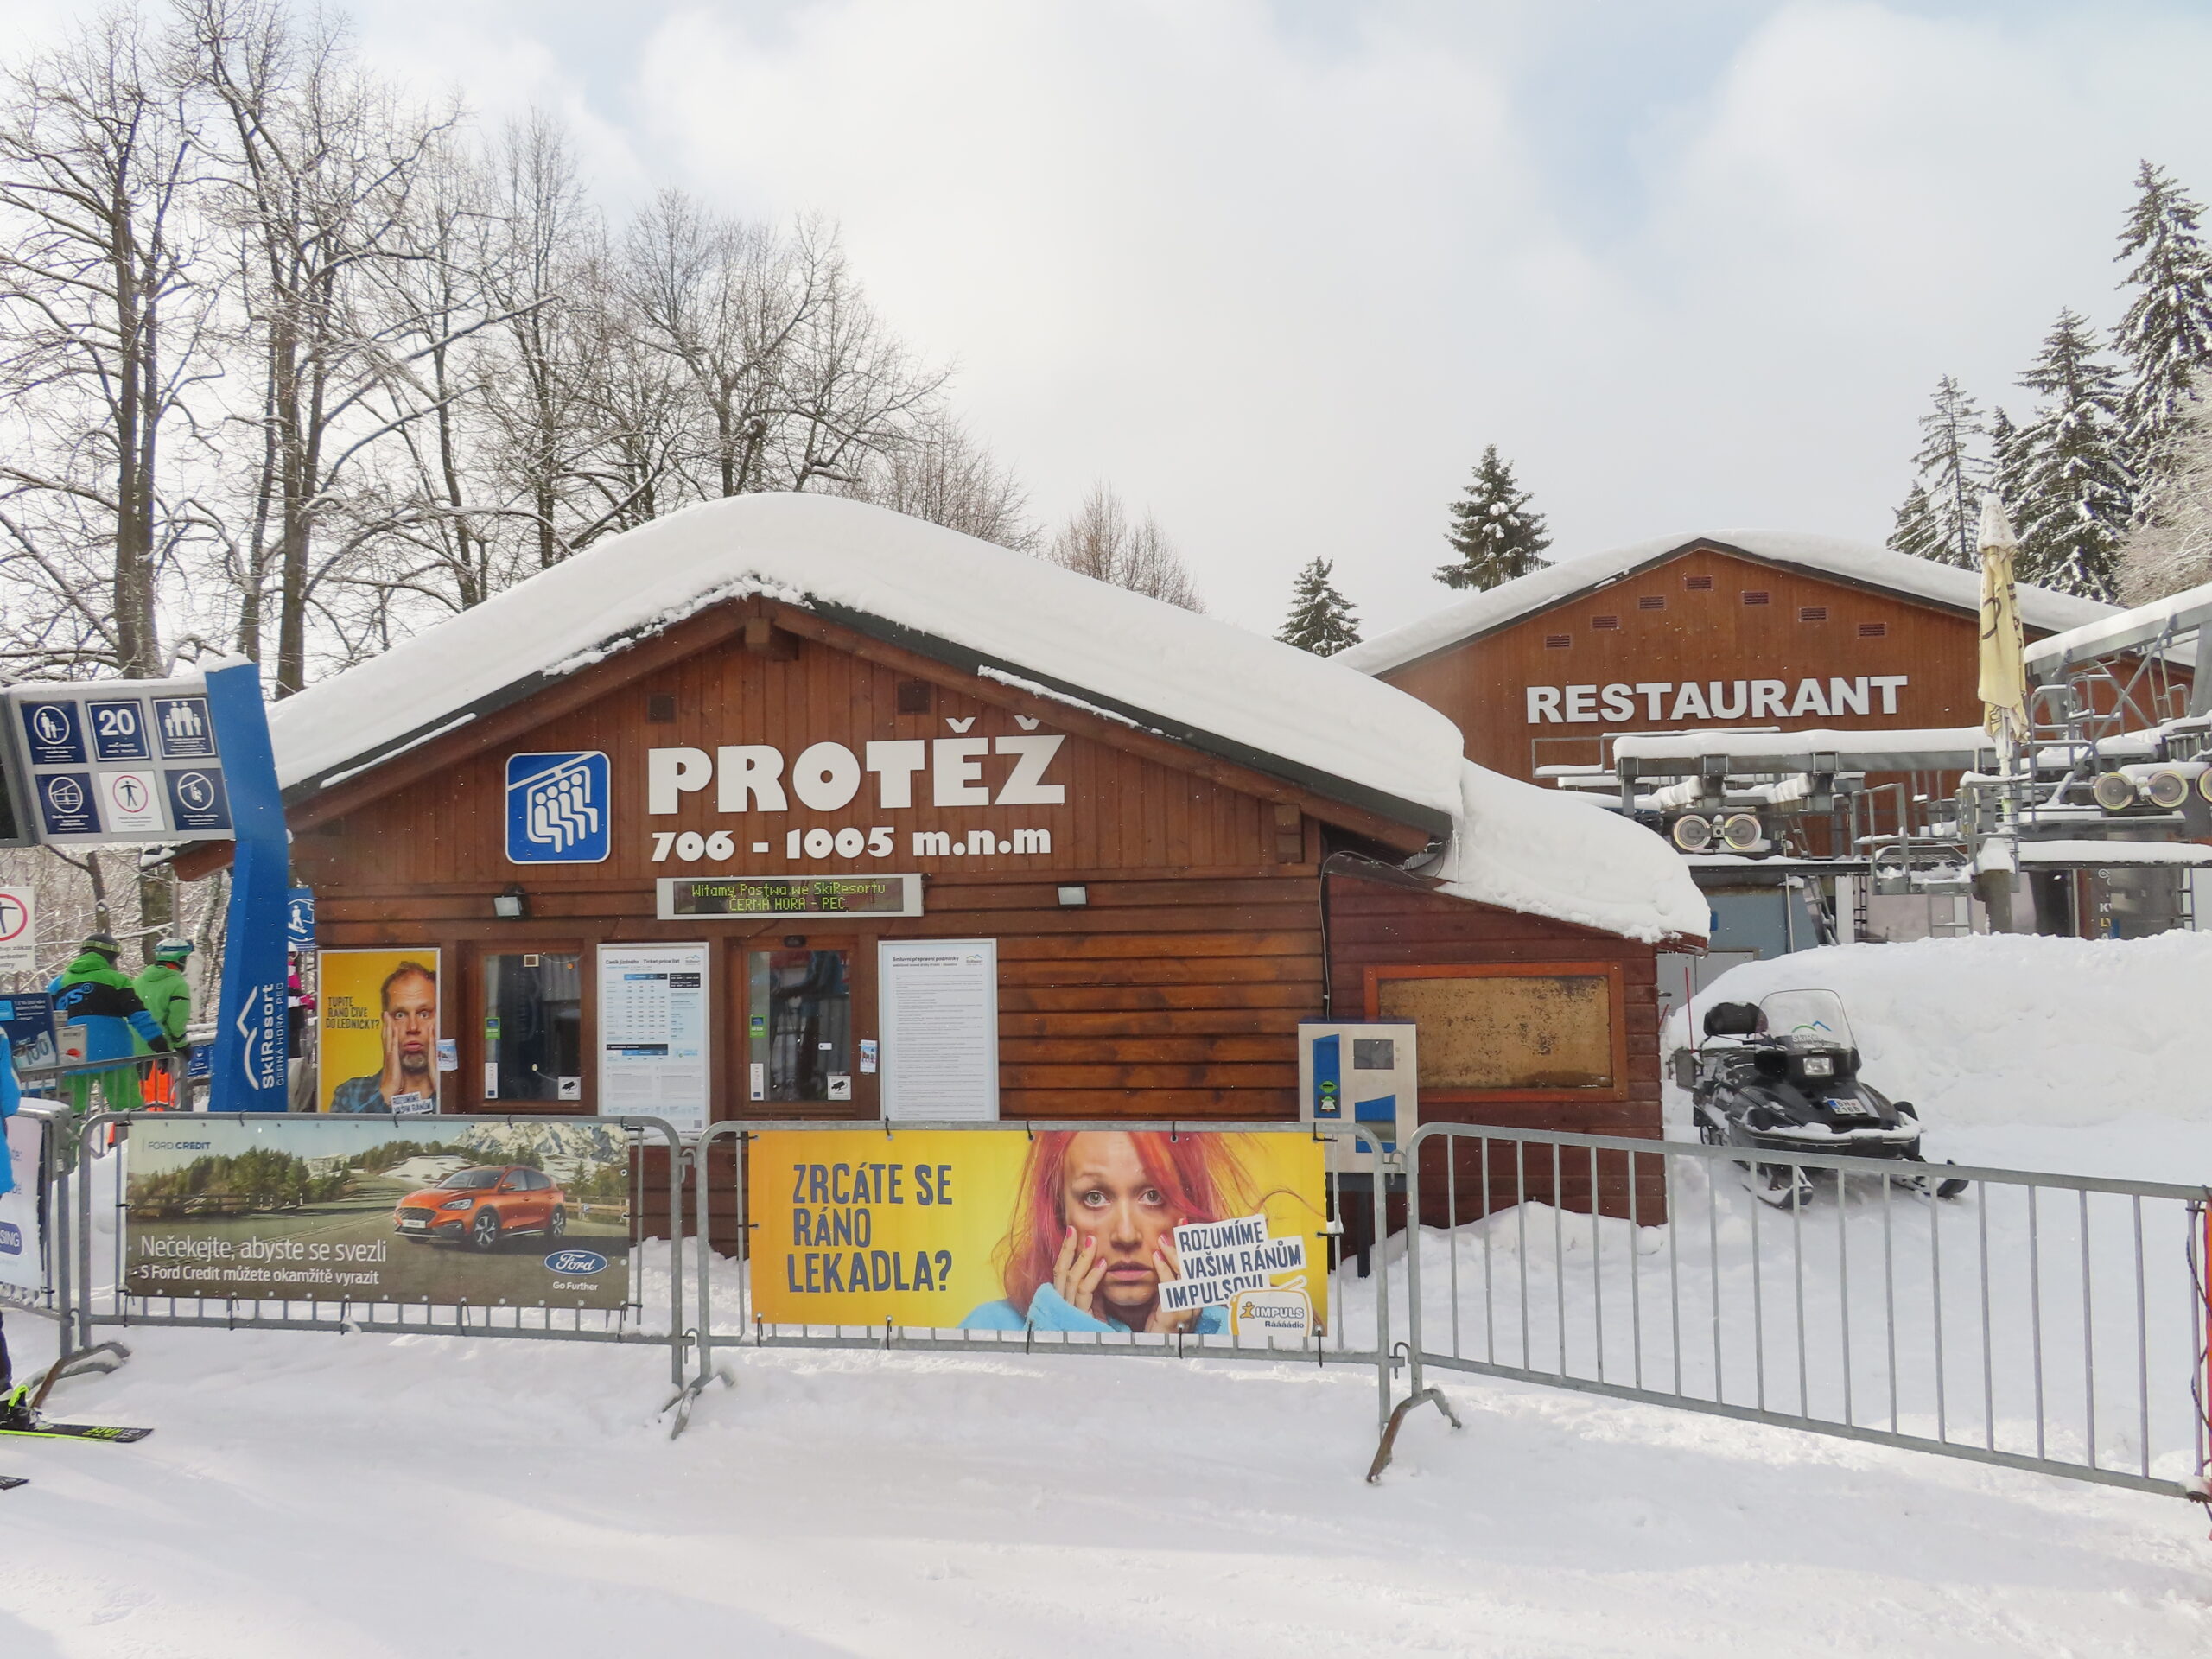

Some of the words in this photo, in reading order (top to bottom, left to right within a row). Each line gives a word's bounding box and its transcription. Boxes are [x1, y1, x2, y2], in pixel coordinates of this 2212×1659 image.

[1526, 675, 1909, 724] RESTAURANT
[99, 709, 136, 736] 20
[649, 715, 1066, 815] PROTĚŽ
[650, 830, 734, 862] 706
[785, 826, 895, 860] 1005
[912, 828, 1052, 857] m.n.m
[691, 885, 734, 897] Witamy
[791, 886, 809, 895] we
[814, 882, 886, 895] SkiResortu
[774, 898, 806, 911] HORA
[822, 897, 847, 910] PEC
[261, 983, 275, 1090] SkiResort
[276, 1013, 284, 1045] HORA
[148, 1141, 174, 1150] FORD
[175, 1141, 211, 1150] CREDIT
[793, 1162, 904, 1204] ZRCÁTE
[914, 1164, 953, 1205] SE
[793, 1206, 871, 1248] RÁNO
[1179, 1219, 1264, 1253] ROZUMÍME
[141, 1235, 235, 1262] Nečekejte,
[240, 1236, 304, 1263] abyste
[309, 1243, 330, 1261] se
[334, 1239, 387, 1262] svezli
[556, 1253, 596, 1271] Ford
[1183, 1250, 1236, 1280] VAŠIM
[1240, 1240, 1301, 1273] RÁNŮM
[140, 1265, 149, 1279] S
[151, 1265, 181, 1280] Ford
[182, 1266, 220, 1281] Credit
[223, 1265, 270, 1281] můžete
[273, 1268, 333, 1283] okamžitě
[335, 1270, 379, 1287] vyrazit
[553, 1281, 565, 1289] Go
[566, 1281, 599, 1291] Further
[787, 1250, 952, 1293] LEKADLA?
[1255, 1306, 1305, 1319] IMPULS
